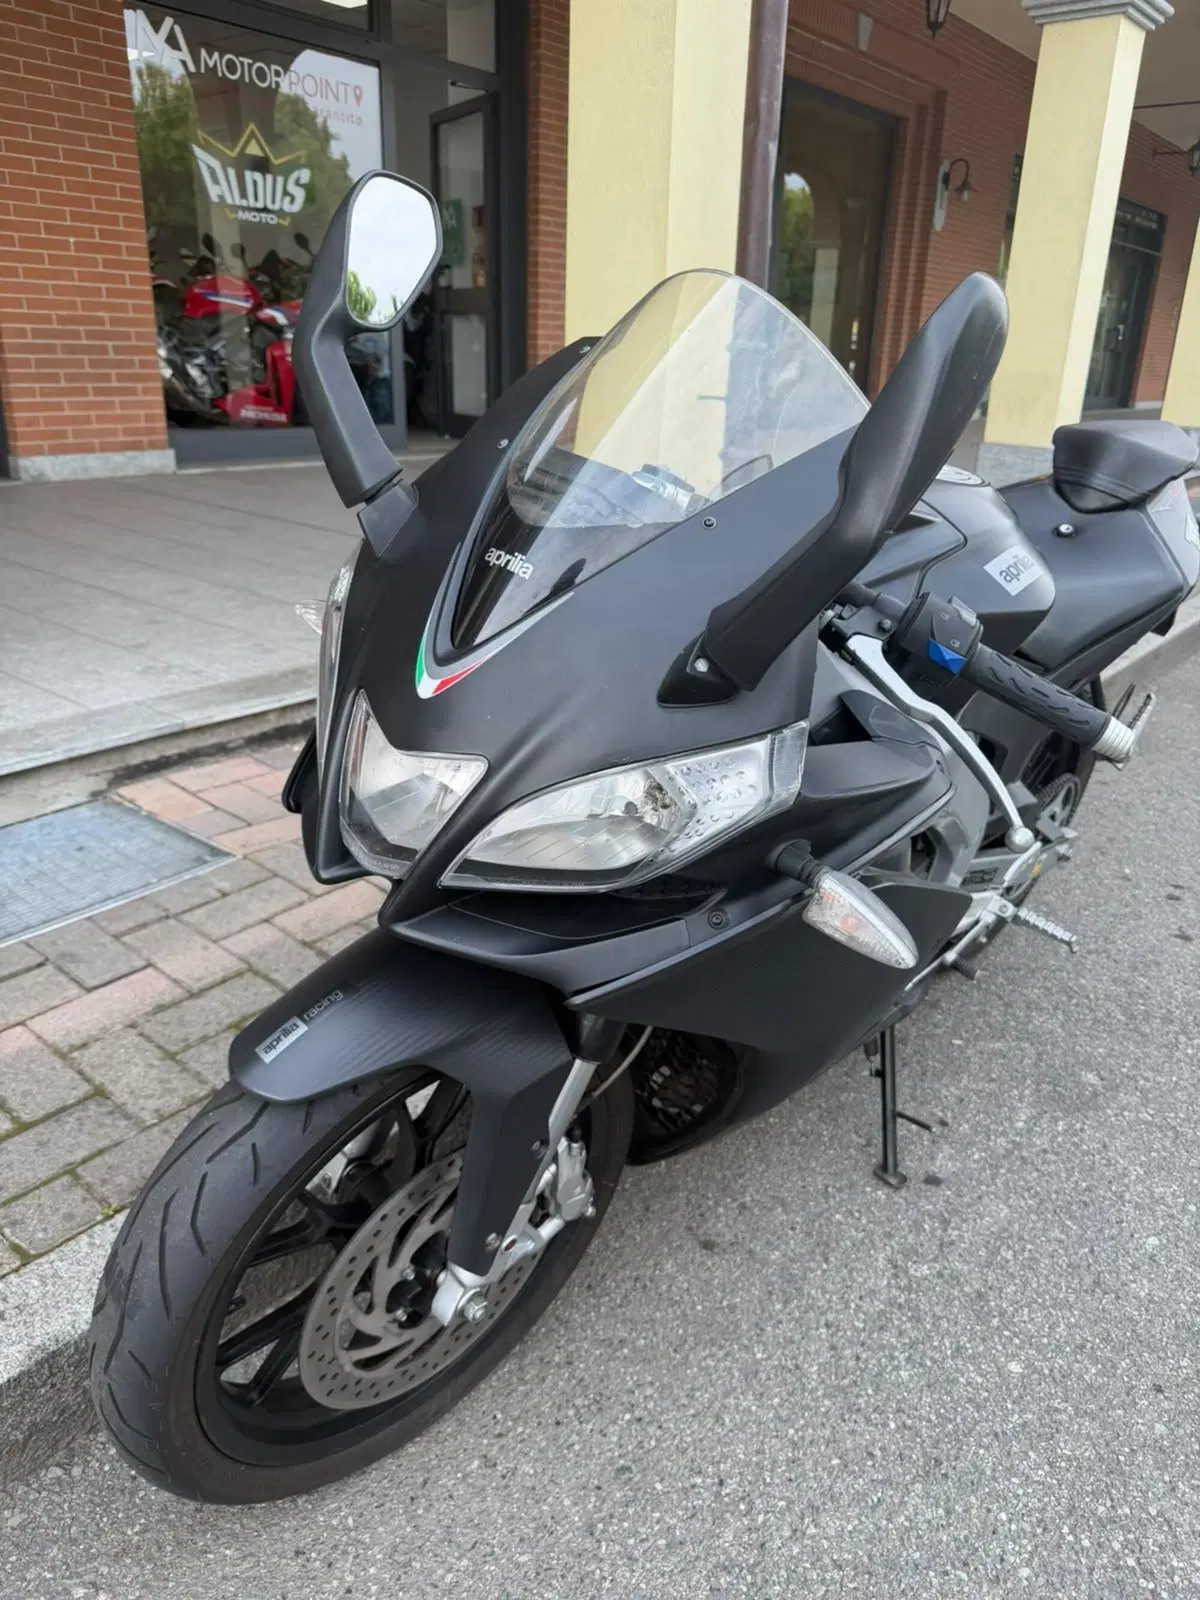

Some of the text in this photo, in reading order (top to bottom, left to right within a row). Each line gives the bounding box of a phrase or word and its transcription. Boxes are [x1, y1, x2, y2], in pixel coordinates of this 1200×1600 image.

[191, 144, 311, 213] ALDUS
[236, 209, 279, 225] MOTO
[484, 547, 534, 580] aprilia
[262, 989, 344, 1055] aprilia racing
